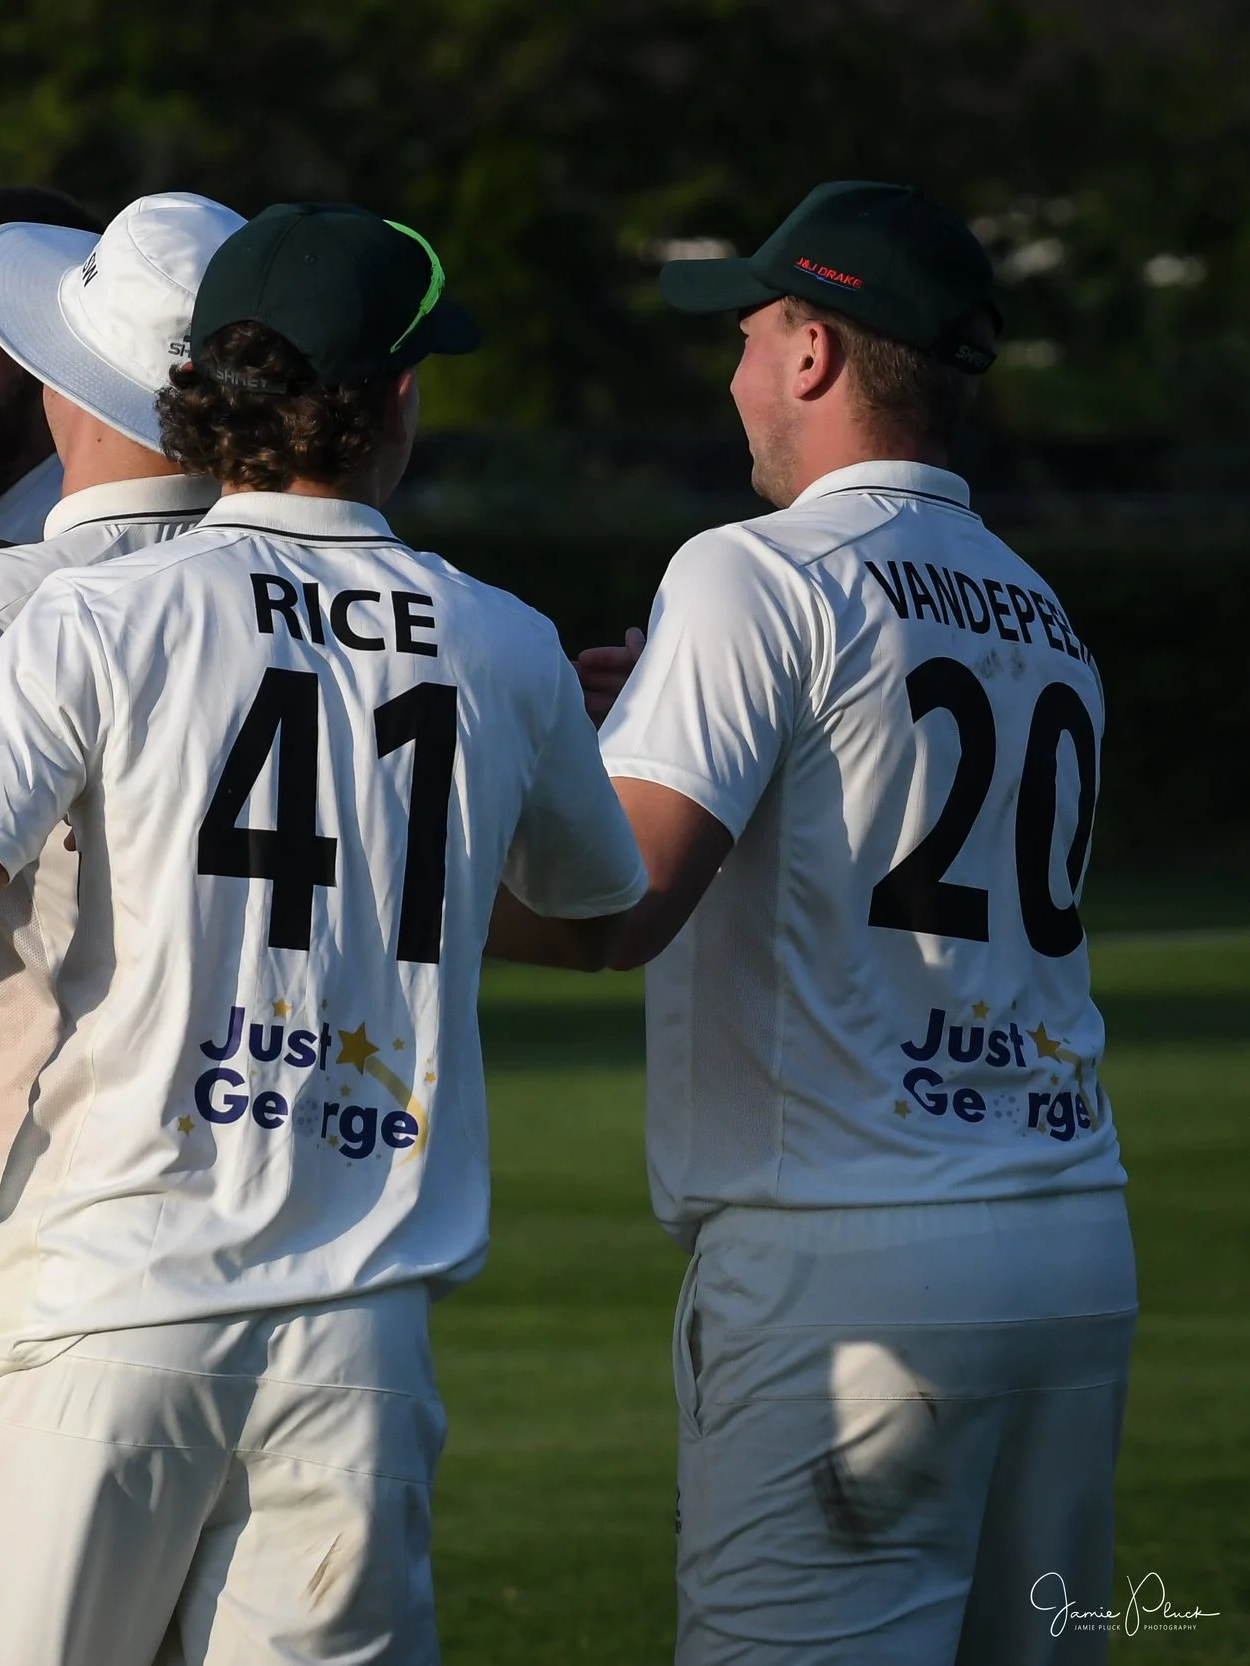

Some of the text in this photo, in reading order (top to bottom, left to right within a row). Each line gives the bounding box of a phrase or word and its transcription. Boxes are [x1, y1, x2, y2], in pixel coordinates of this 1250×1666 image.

[796, 257, 862, 288] J&J DRAKE
[249, 573, 439, 658] RICE
[196, 667, 458, 965] 41
[867, 656, 1097, 958] 20
[199, 1006, 332, 1071] Just
[901, 1007, 1026, 1068] Just
